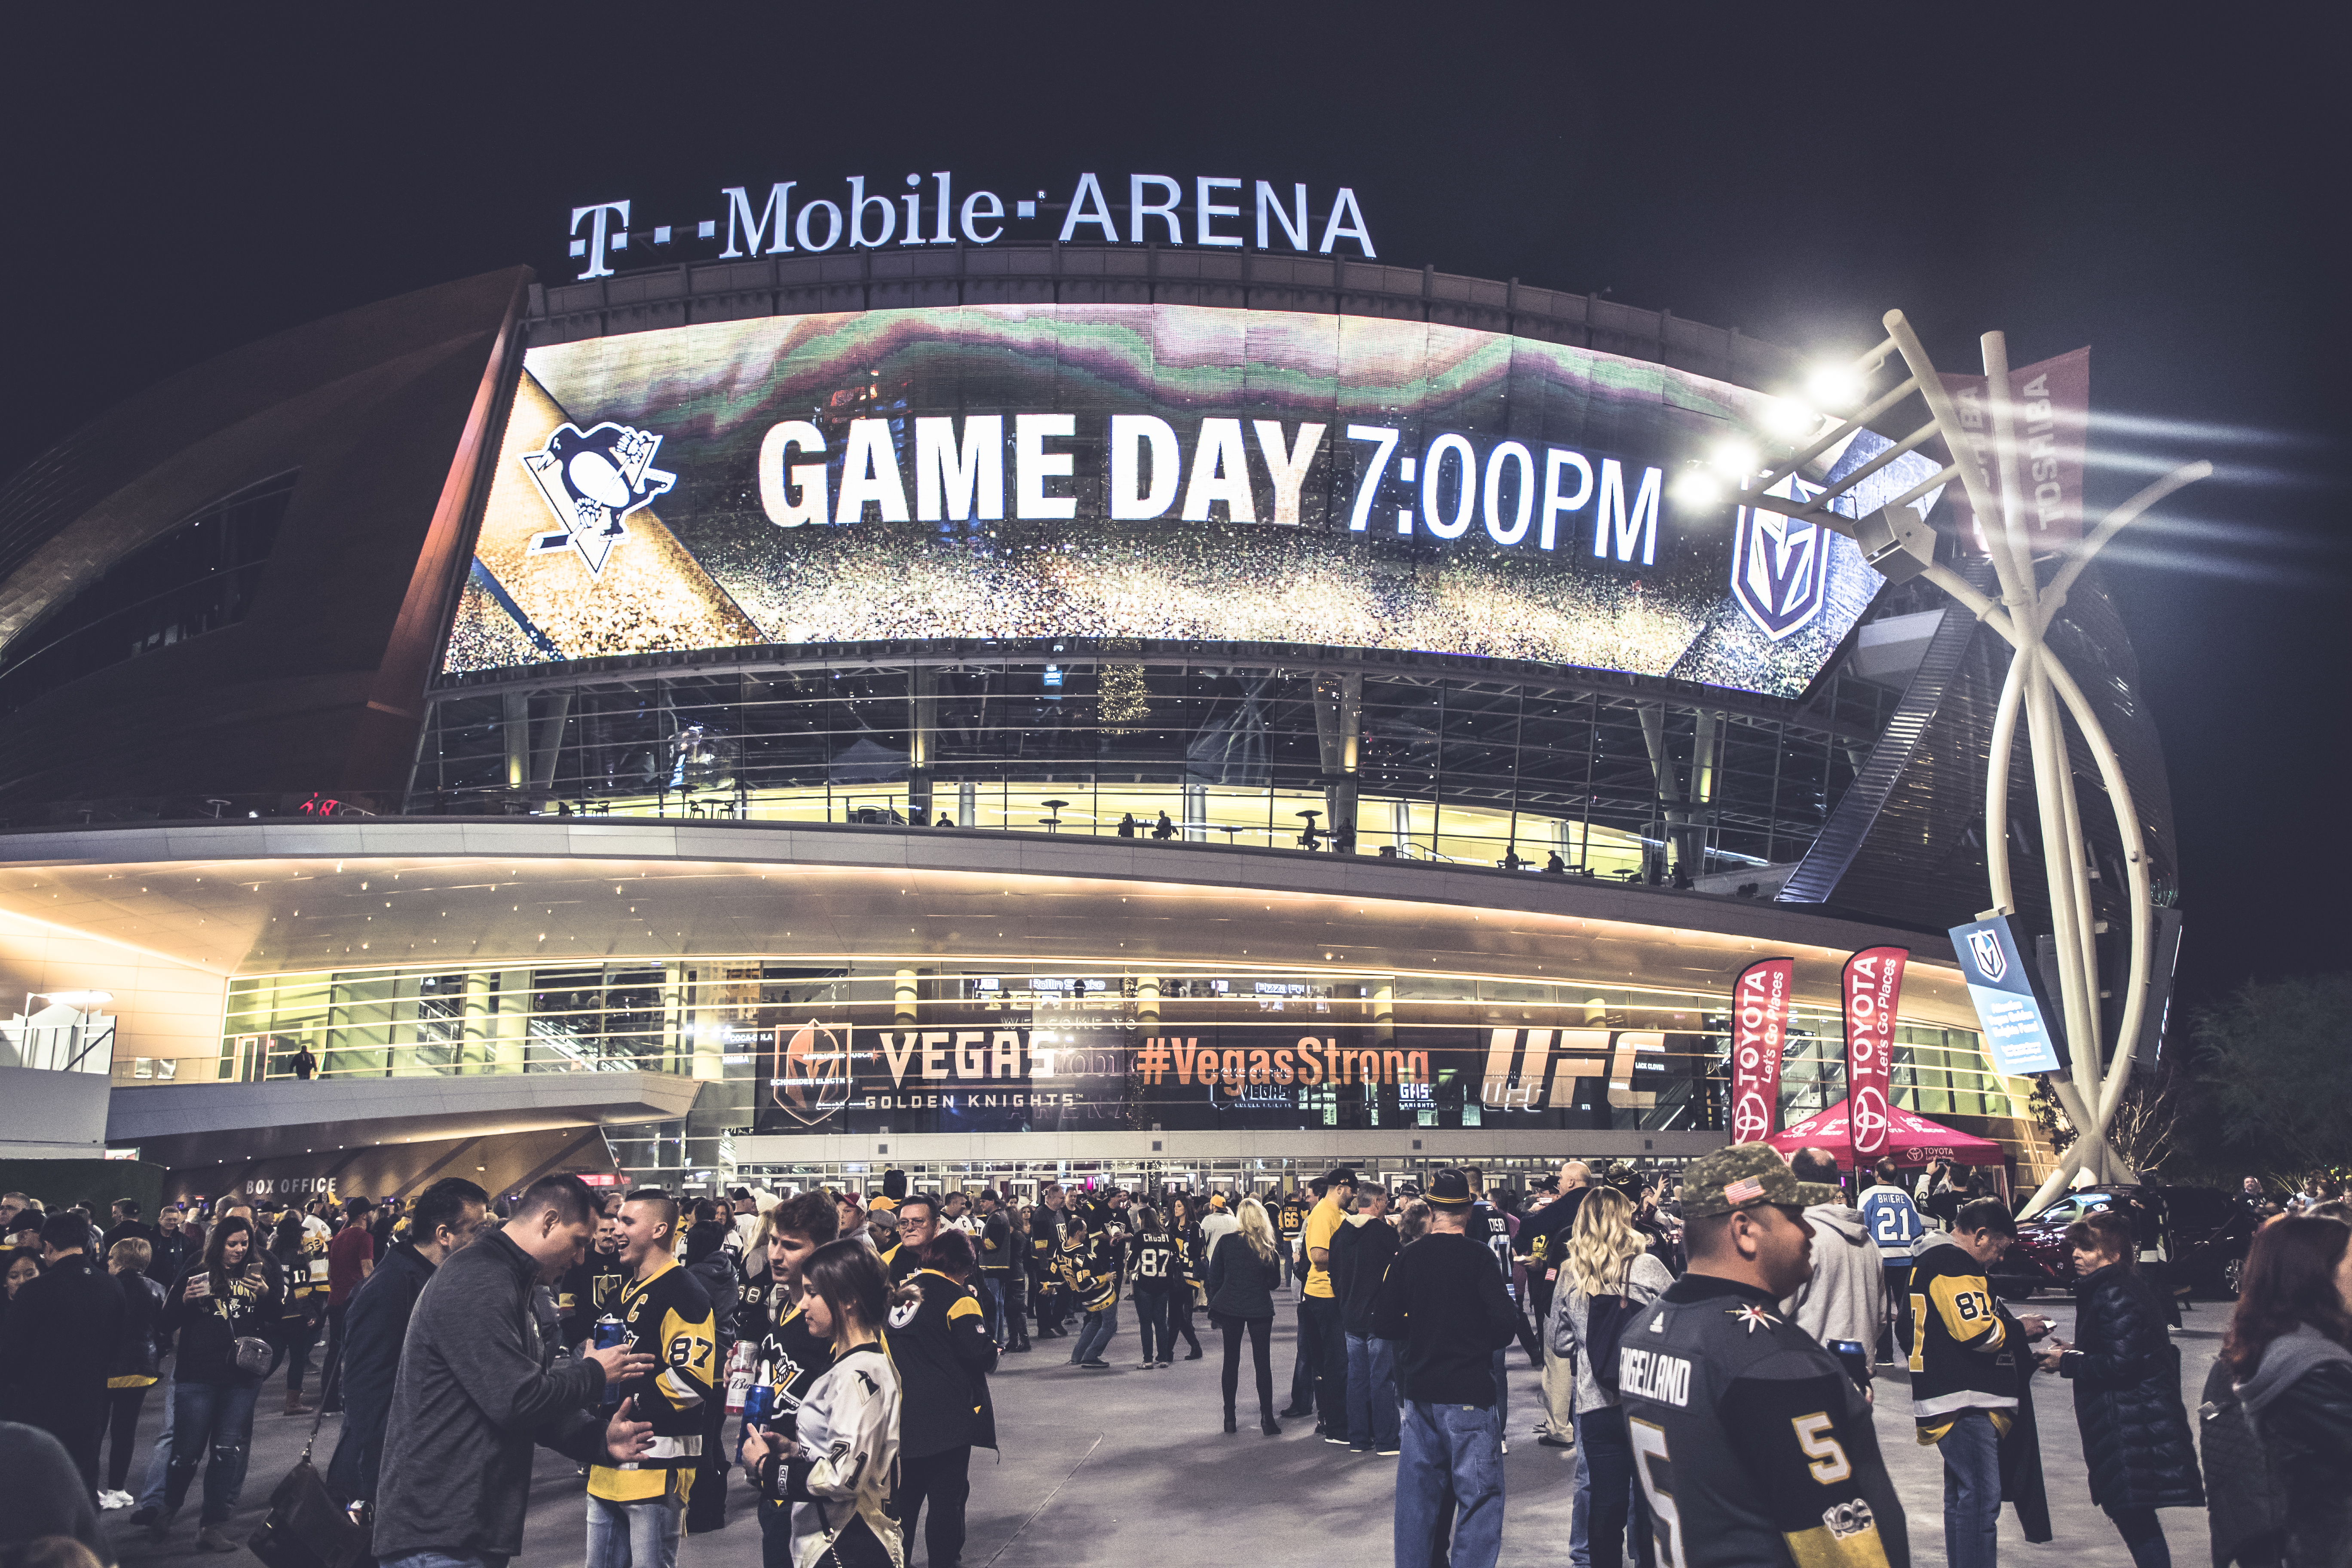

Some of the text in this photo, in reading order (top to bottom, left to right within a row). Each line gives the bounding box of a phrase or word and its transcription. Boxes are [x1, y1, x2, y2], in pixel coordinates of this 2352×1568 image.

[1060, 172, 1377, 259] ARENA
[2023, 373, 2064, 531] TOSHIBA
[759, 414, 1663, 566] GAME DAY 7:00PM
[1064, 979, 1106, 990] Soke
[1739, 970, 1767, 1087] TOYOTA
[1761, 971, 1783, 1083] Let's Go Places
[1852, 956, 1878, 1080] TOYOTA
[1877, 958, 1896, 1076] Let's Go Places
[730, 1033, 773, 1043] COCA-CLA
[879, 1031, 1055, 1089] VEGAS
[1137, 1036, 1429, 1096] #VegasStrong
[1480, 1029, 1665, 1109] UFC
[770, 1078, 814, 1086] SCHNEIDER
[865, 1094, 953, 1109] GOLDEN
[968, 1093, 1074, 1108] KNIGHTS
[246, 1177, 337, 1194] BOX OFFICE
[1877, 1194, 1905, 1204] BRIERE
[1284, 1212, 1298, 1228] 66
[1877, 1207, 1911, 1240] 21
[293, 1270, 306, 1283] 17
[1141, 1249, 1170, 1277] 87
[628, 1293, 648, 1323] C
[1955, 1292, 1992, 1322] 87
[669, 1336, 714, 1368] 87
[1792, 1411, 1852, 1485] 5
